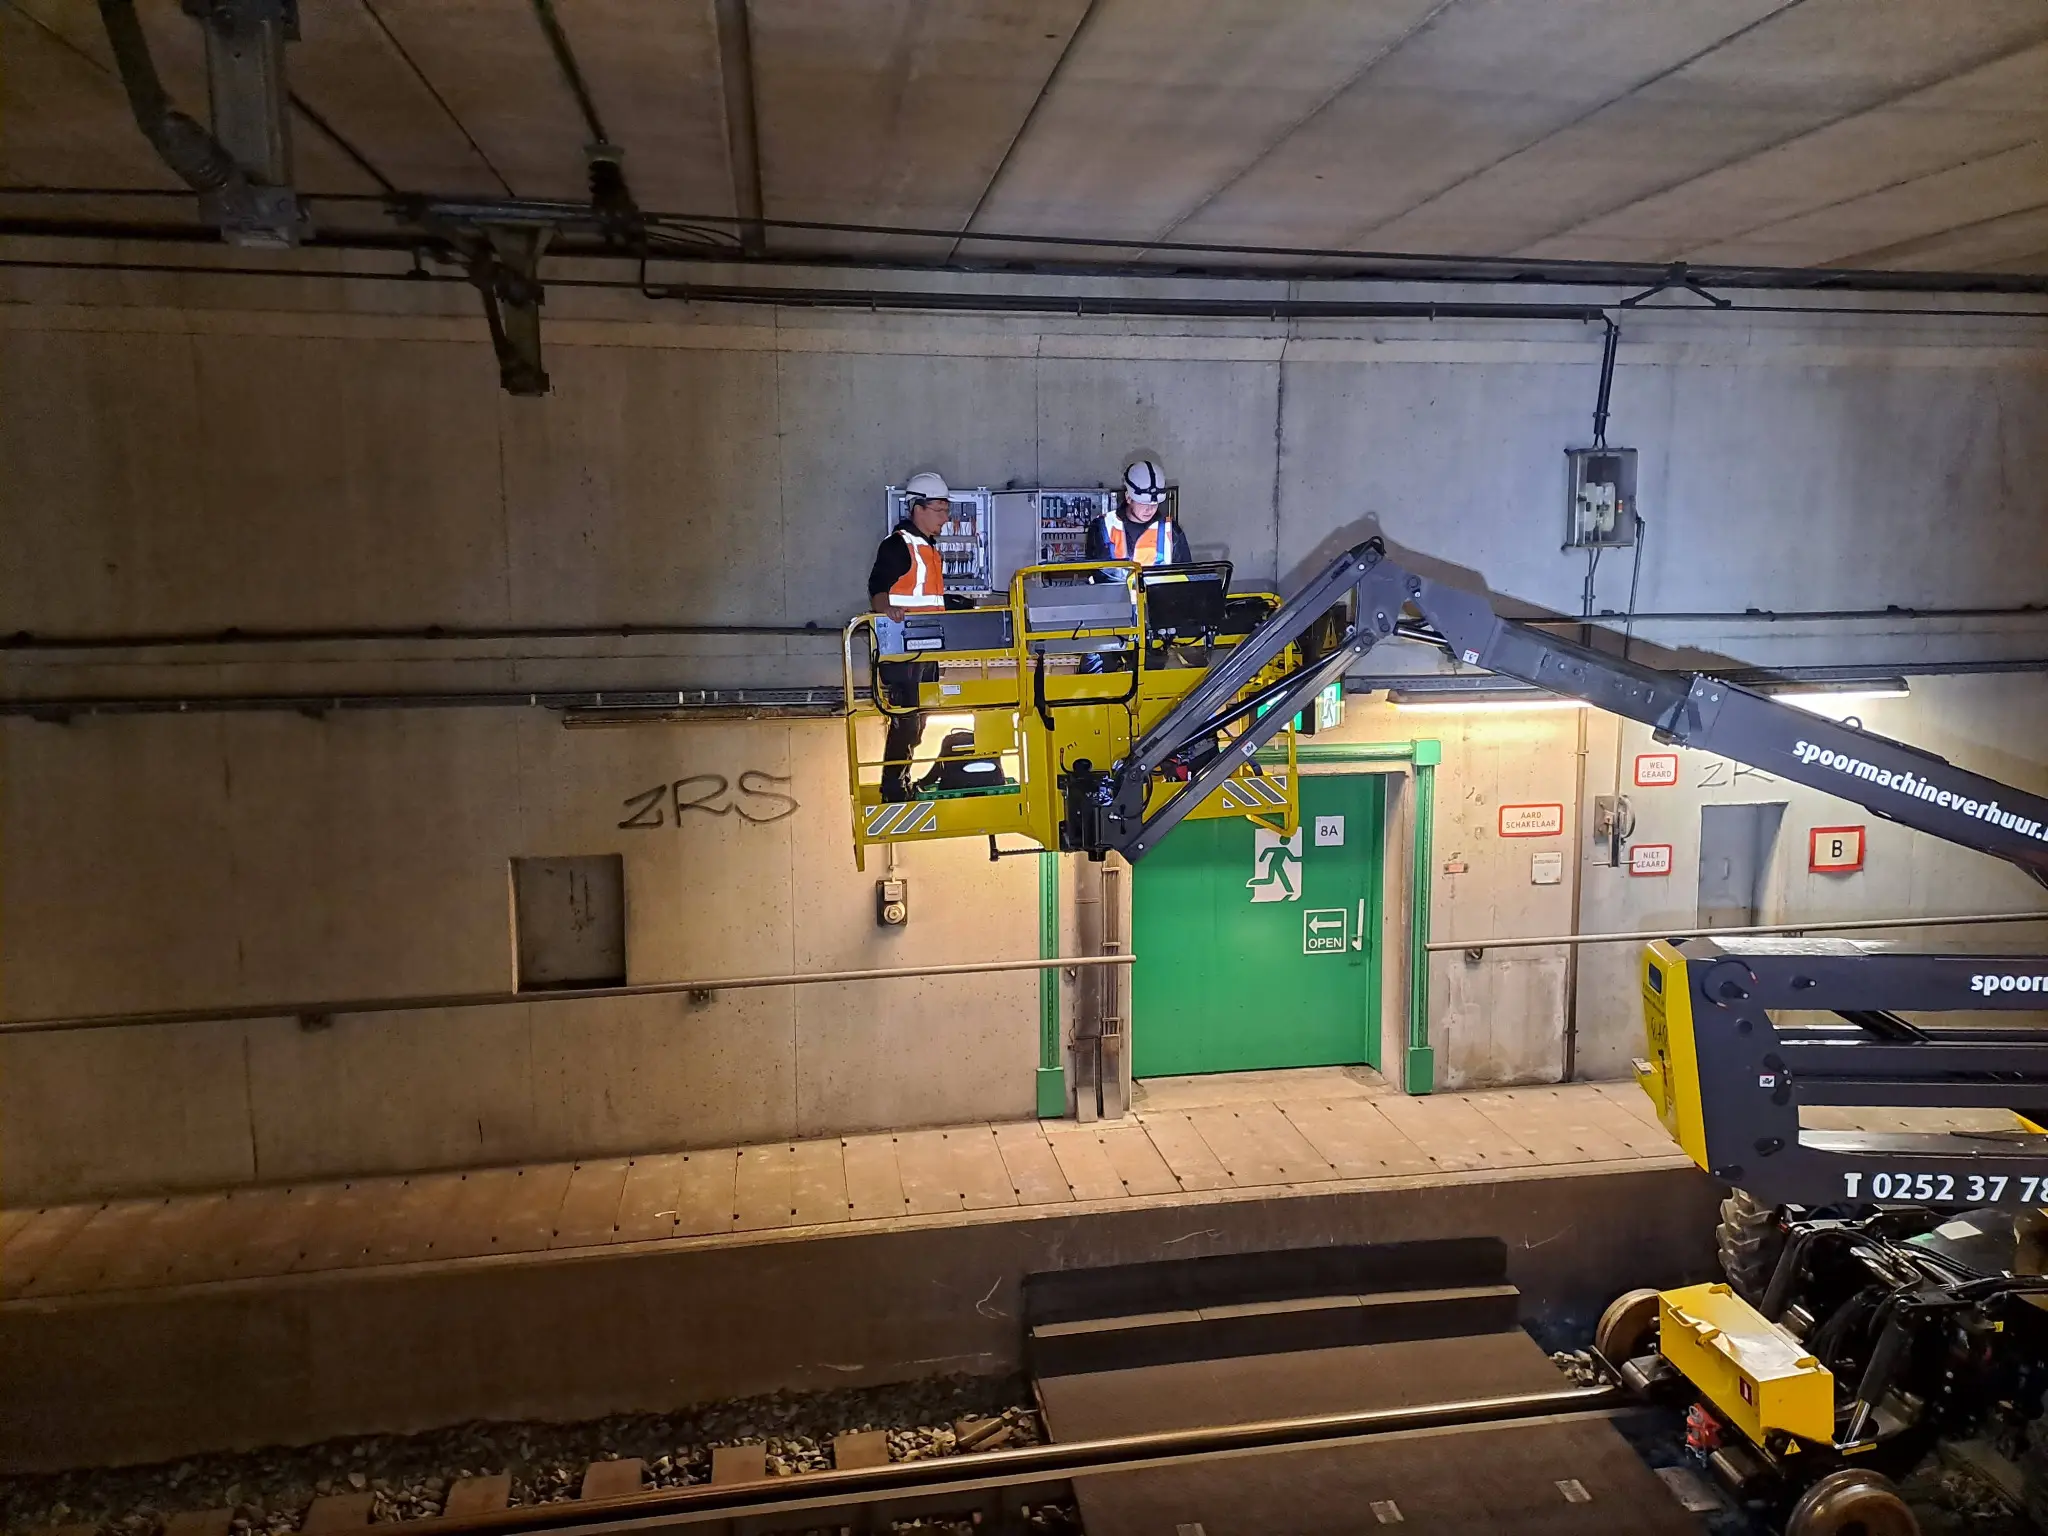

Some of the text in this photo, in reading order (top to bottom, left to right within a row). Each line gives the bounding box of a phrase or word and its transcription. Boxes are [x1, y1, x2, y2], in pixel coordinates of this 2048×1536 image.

[1649, 761, 1664, 769] WEL
[1641, 770, 1672, 779] GEAARD
[618, 769, 800, 829] ZRS
[1520, 811, 1542, 819] AARD
[1505, 820, 1556, 829] SCHAKELAAR
[1320, 825, 1338, 837] 8A
[1832, 840, 1843, 857] B
[1643, 851, 1660, 859] NIET
[1636, 861, 1666, 869] GEAARD
[1308, 937, 1342, 949] OPEN
[1970, 975, 2048, 996] spoor
[1844, 1172, 1862, 1198] T
[1872, 1173, 1955, 1200] 0252
[1966, 1175, 2009, 1202] 37
